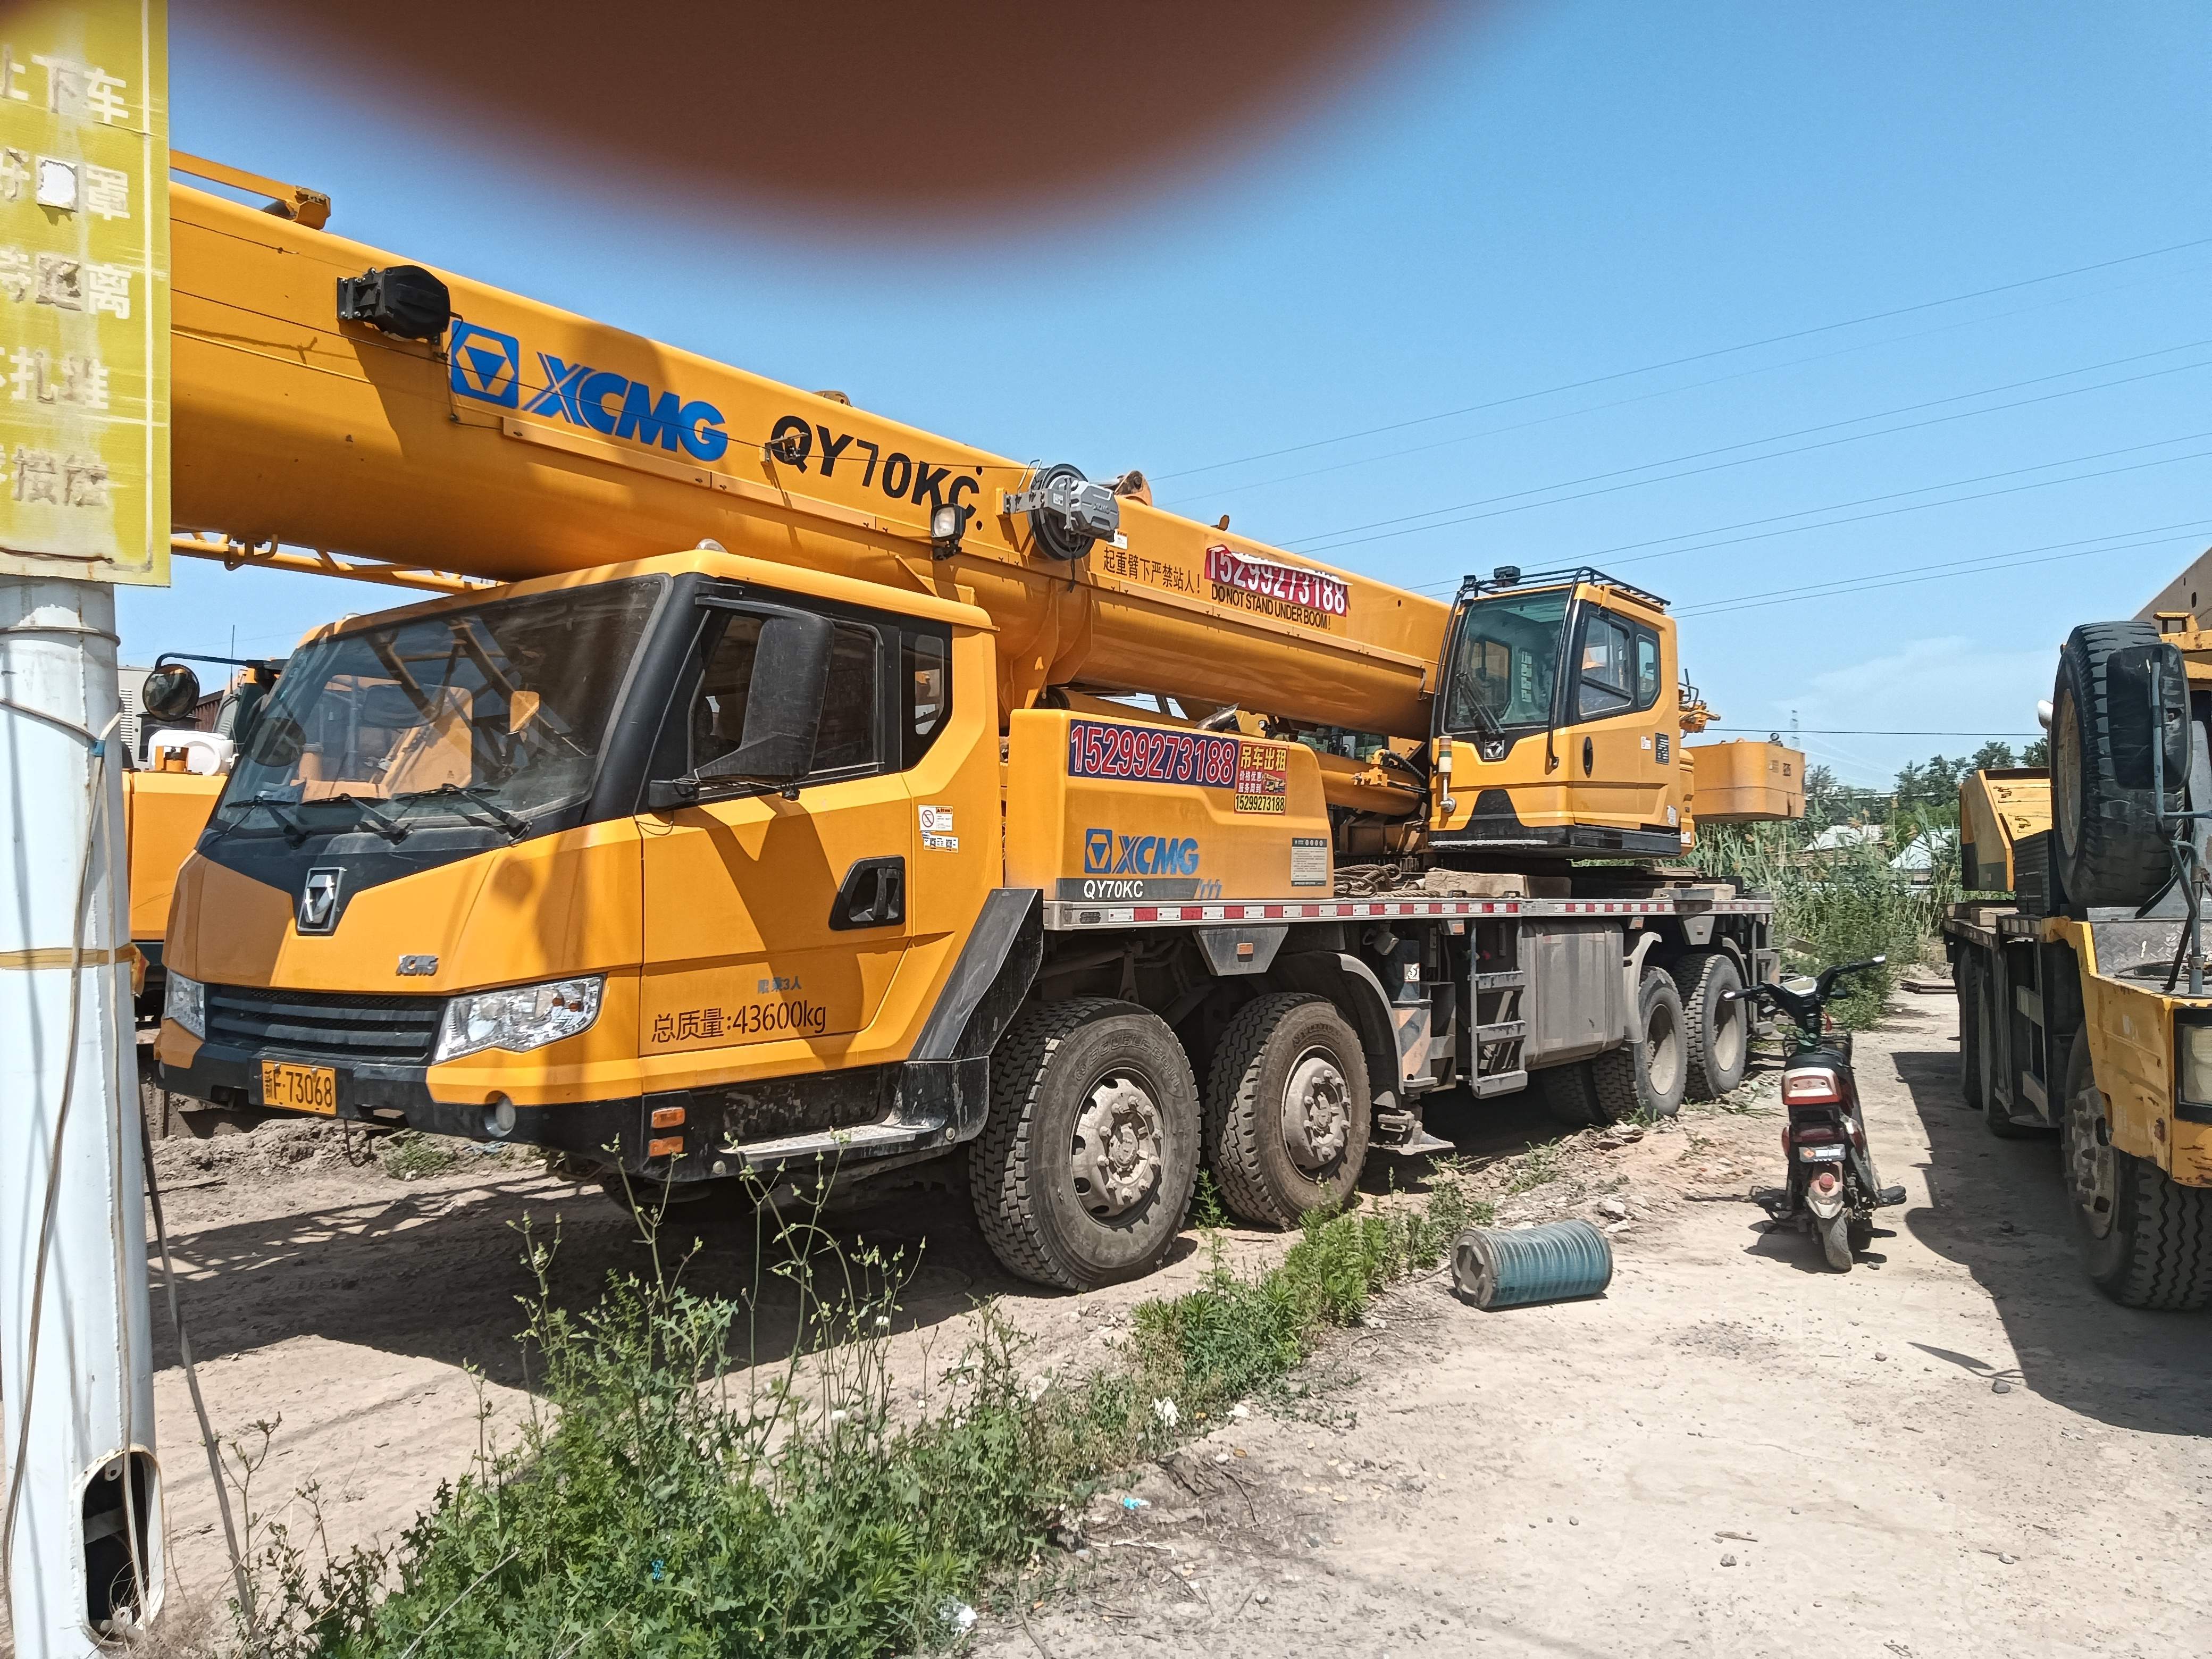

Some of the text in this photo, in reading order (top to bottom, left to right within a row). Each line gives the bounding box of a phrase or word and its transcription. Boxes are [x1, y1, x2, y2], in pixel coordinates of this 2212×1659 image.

[0, 347, 108, 409] 扎堆
[521, 351, 728, 462] XCMG
[0, 445, 110, 508] 接触
[771, 415, 980, 520] QY70KC
[1103, 546, 1200, 594] 起重臂下严禁站人！
[1211, 583, 1226, 602] DO
[1227, 588, 1245, 608] NOT
[1245, 593, 1273, 616] STAND
[1275, 601, 1303, 624] UNDER
[1071, 725, 1236, 785] 15299273188
[1239, 770, 1262, 782] 价格优惠
[1240, 746, 1287, 772] 吊车出租
[1236, 795, 1285, 812] 15299273188
[1238, 782, 1262, 794] 服务周到
[1111, 835, 1200, 876] XCMG
[1084, 879, 1144, 900] QY70KC
[651, 1000, 826, 1043] 总质量:43600kg
